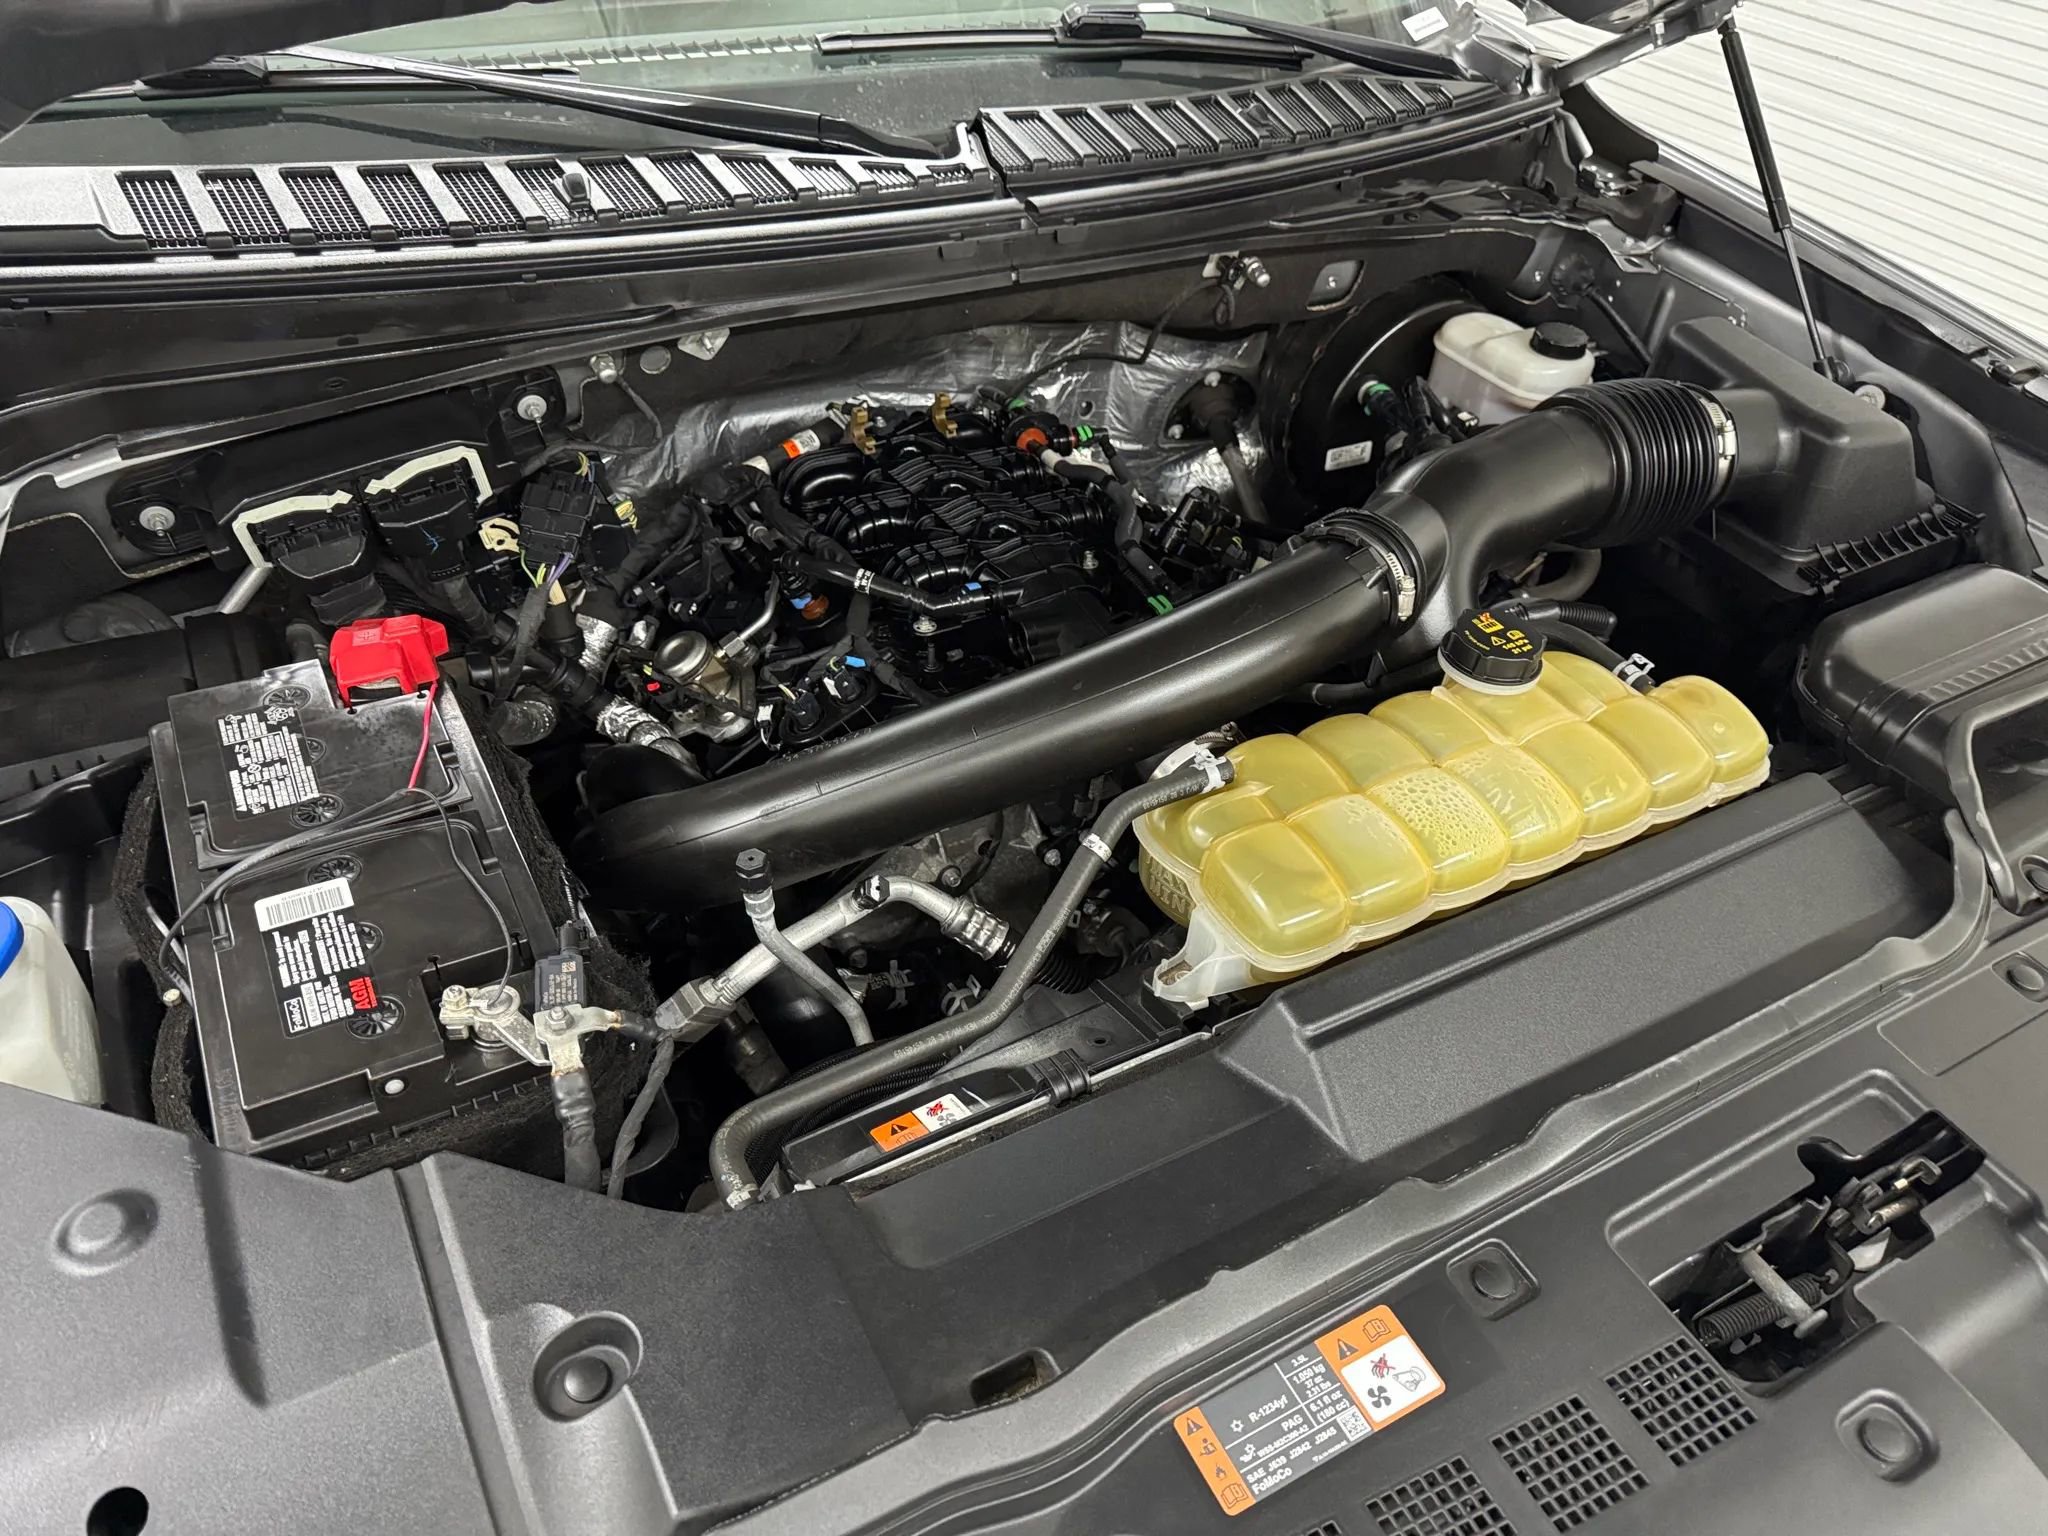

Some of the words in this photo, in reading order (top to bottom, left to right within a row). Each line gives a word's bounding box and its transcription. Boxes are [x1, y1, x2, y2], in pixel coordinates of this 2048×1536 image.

[1148, 875, 1187, 913] MIN
[349, 978, 371, 1009] AGM
[288, 998, 305, 1030] FoMoCo
[1292, 1368, 1314, 1385] 1.050
[1314, 1363, 1325, 1375] kg
[1305, 1379, 1314, 1388] 37
[1306, 1386, 1321, 1398] 2.31
[1319, 1379, 1331, 1390] lbs
[1248, 1395, 1288, 1422] R-1234yf
[1310, 1399, 1321, 1412] 6.1
[1330, 1390, 1342, 1400] oz
[1317, 1407, 1335, 1422] (180
[1335, 1398, 1350, 1412] cc)
[1281, 1414, 1303, 1431] PAG
[1247, 1468, 1265, 1483] SAE
[1252, 1468, 1292, 1494] FoMoCo
